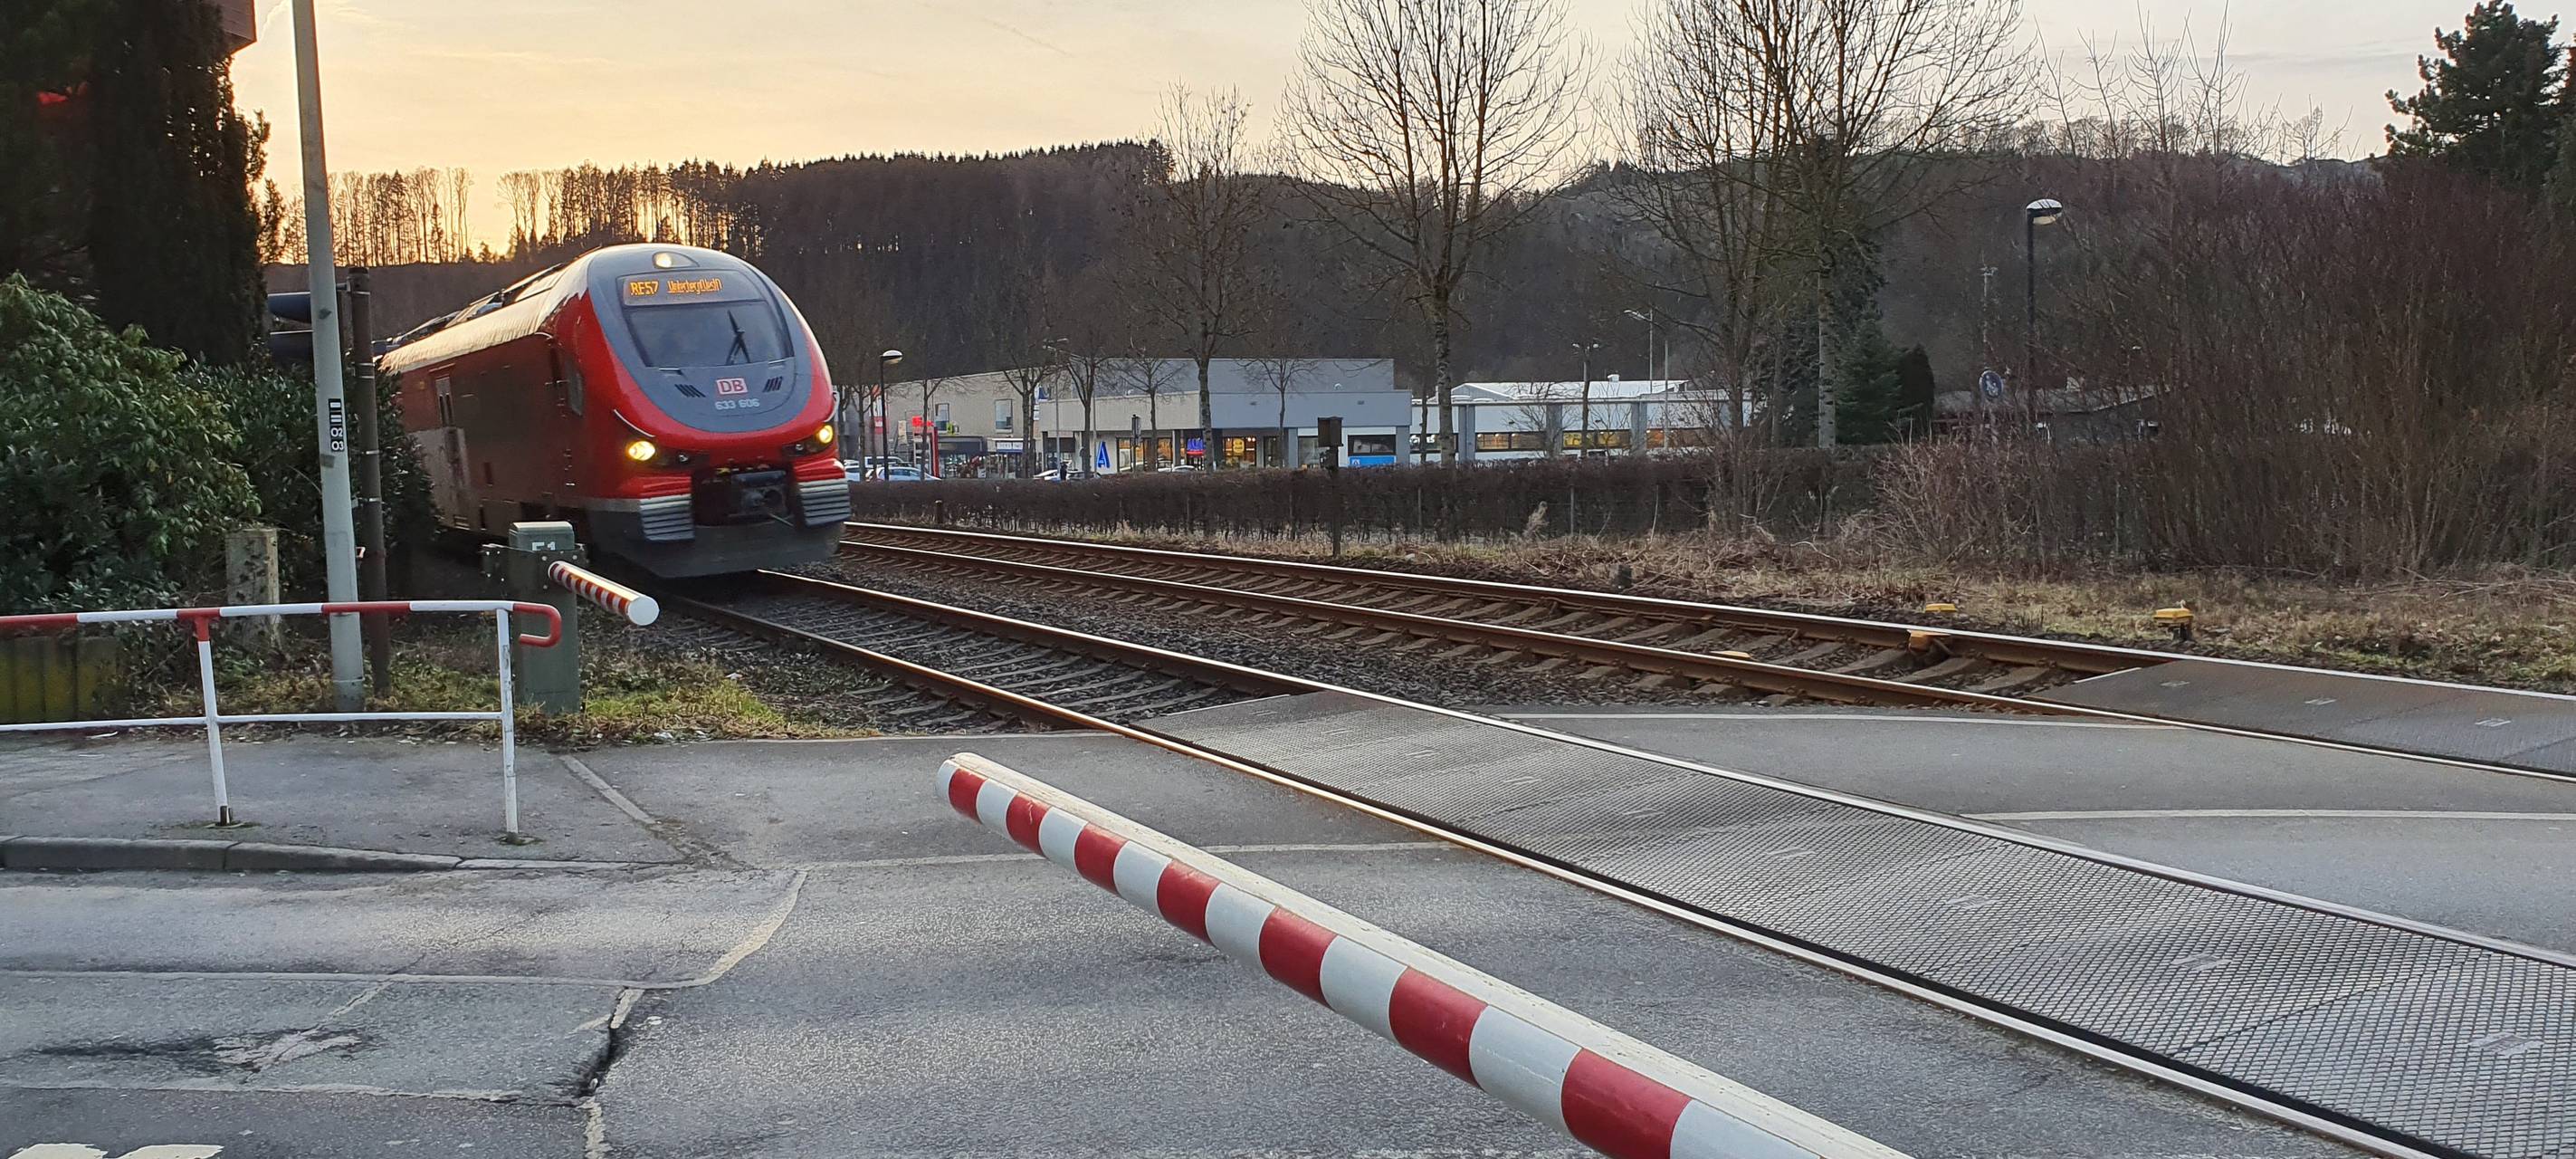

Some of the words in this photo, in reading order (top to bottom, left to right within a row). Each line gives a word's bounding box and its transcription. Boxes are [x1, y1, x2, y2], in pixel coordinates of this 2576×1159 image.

[630, 281, 659, 295] RE57
[719, 379, 745, 393] DB
[715, 400, 736, 410] 633
[738, 398, 760, 408] 606
